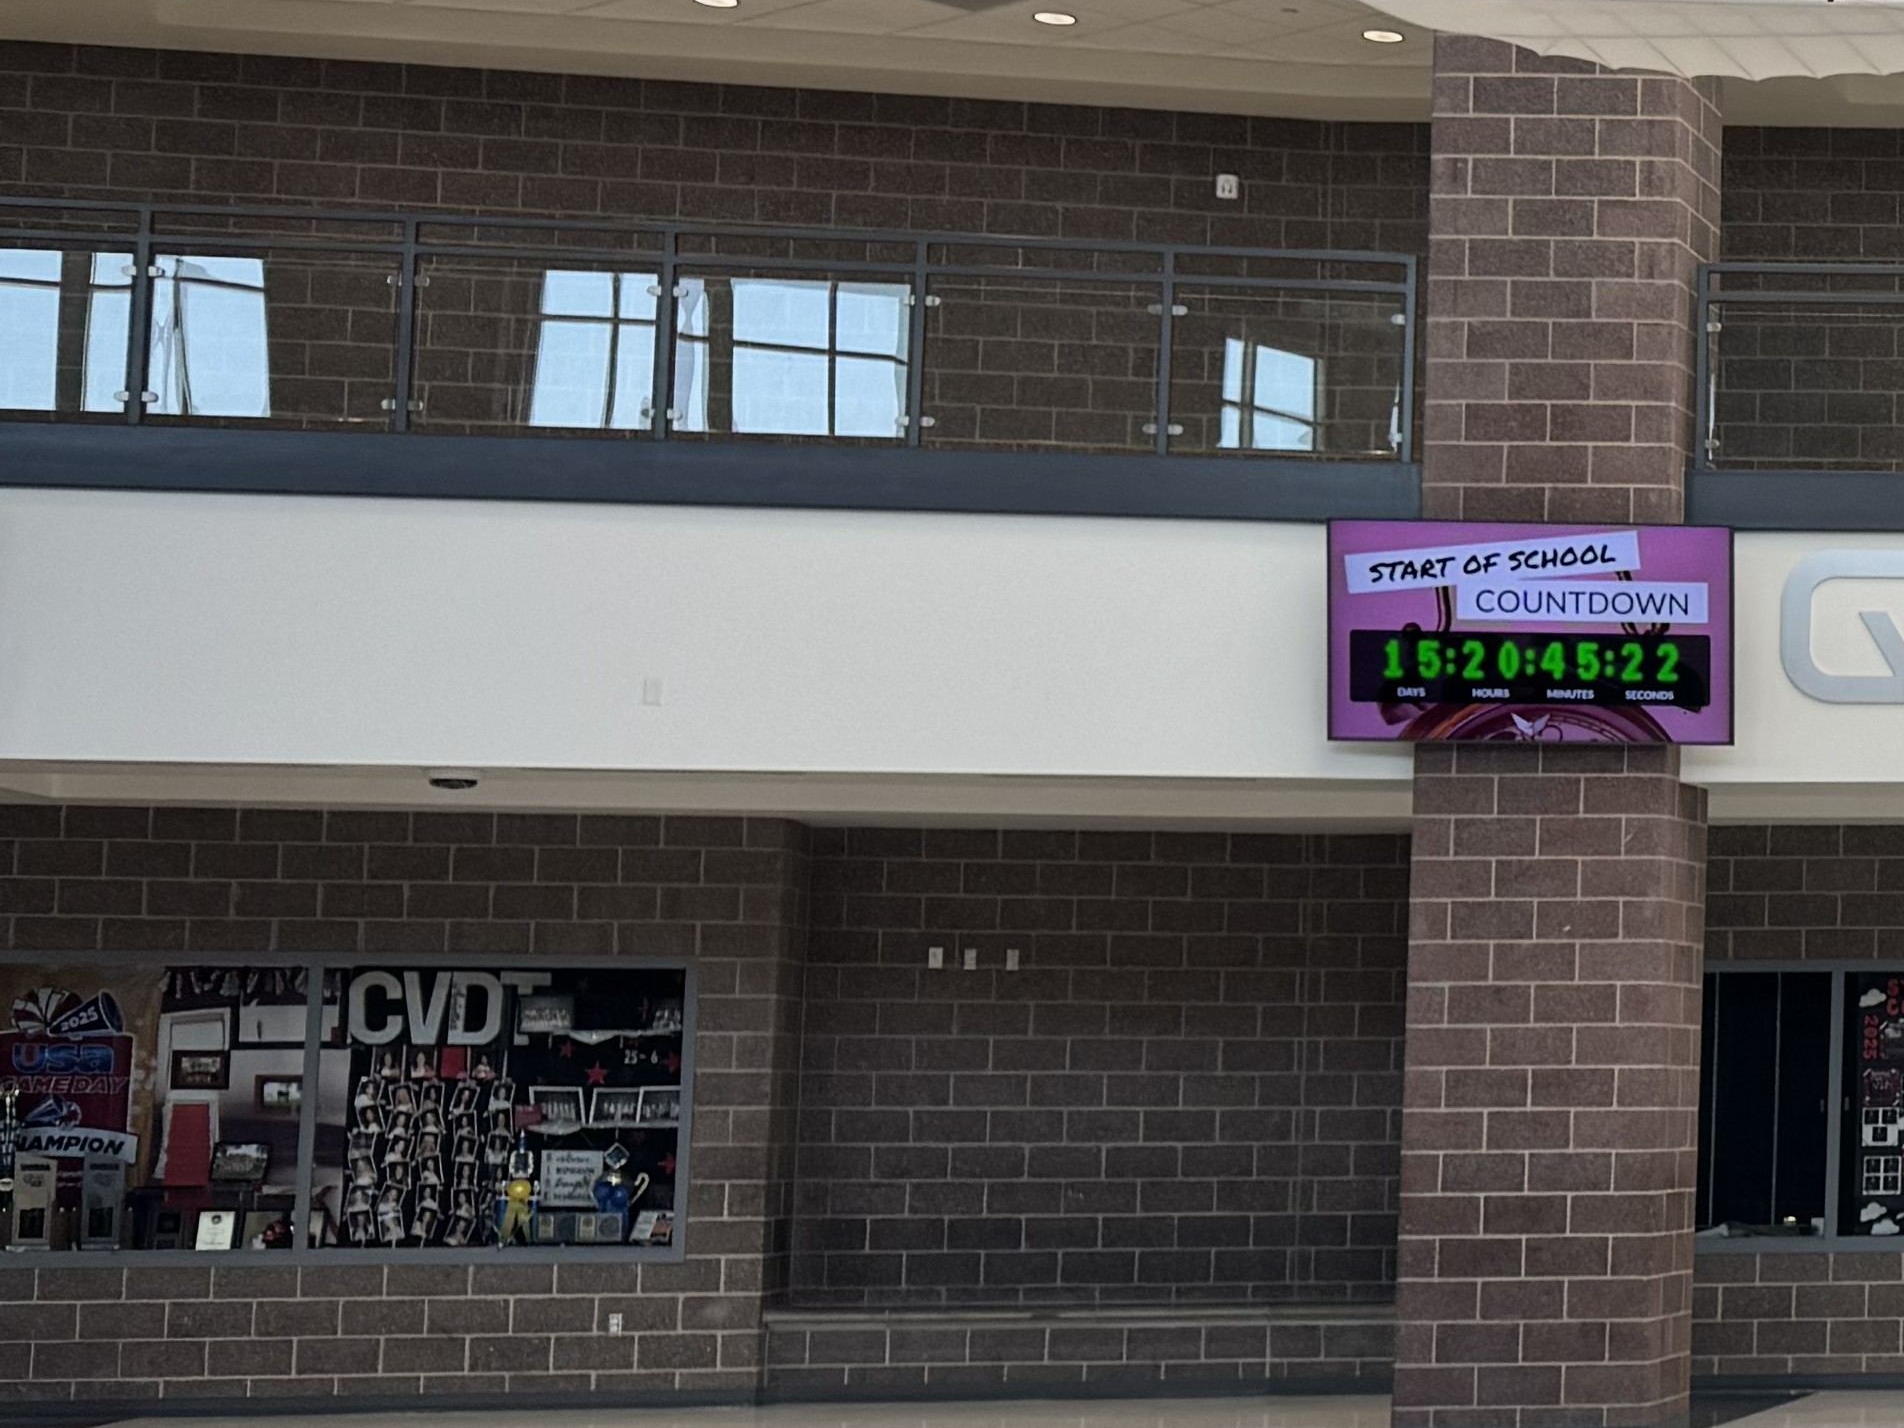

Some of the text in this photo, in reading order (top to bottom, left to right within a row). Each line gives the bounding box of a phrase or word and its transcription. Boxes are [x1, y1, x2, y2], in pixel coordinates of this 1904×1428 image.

[1369, 544, 1617, 583] START OF SCHOOL
[1475, 588, 1689, 616] COUNTDOWN
[1397, 686, 1675, 701] DAYS HOURS MINUTES SECONDS
[60, 1007, 99, 1031] 2025
[16, 1135, 125, 1155] HAMPION
